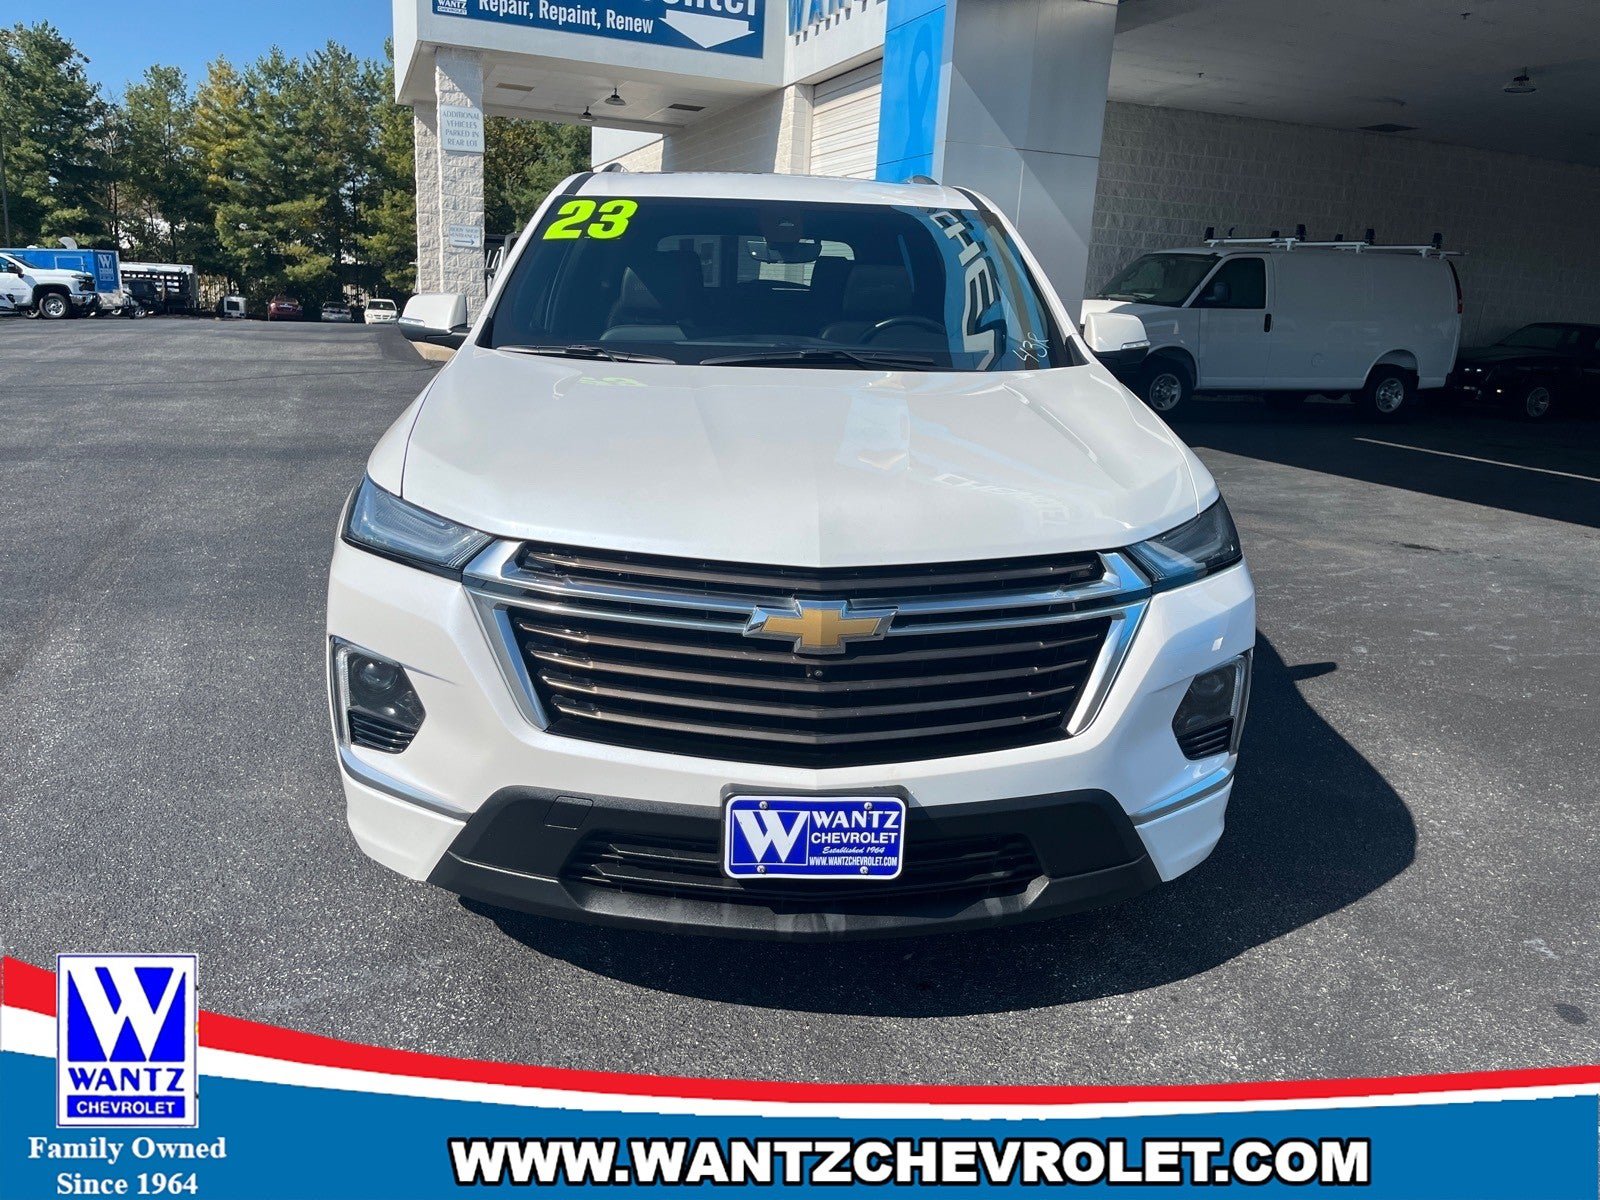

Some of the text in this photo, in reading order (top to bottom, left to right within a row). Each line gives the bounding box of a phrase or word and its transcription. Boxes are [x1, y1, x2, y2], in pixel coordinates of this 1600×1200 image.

[478, 0, 654, 33] Repair, Repaint, Renew
[443, 110, 480, 120] ADDITIONAL
[446, 120, 478, 129] VEHICLES
[445, 128, 470, 137] PARKED
[447, 138, 465, 146] REAR
[543, 200, 638, 239] 23
[812, 810, 900, 828] WANTZ
[811, 832, 898, 844] CHEVROLET
[822, 846, 886, 854] Established 1964
[809, 856, 898, 867] WWW.WANTZCHEVROLET.COM
